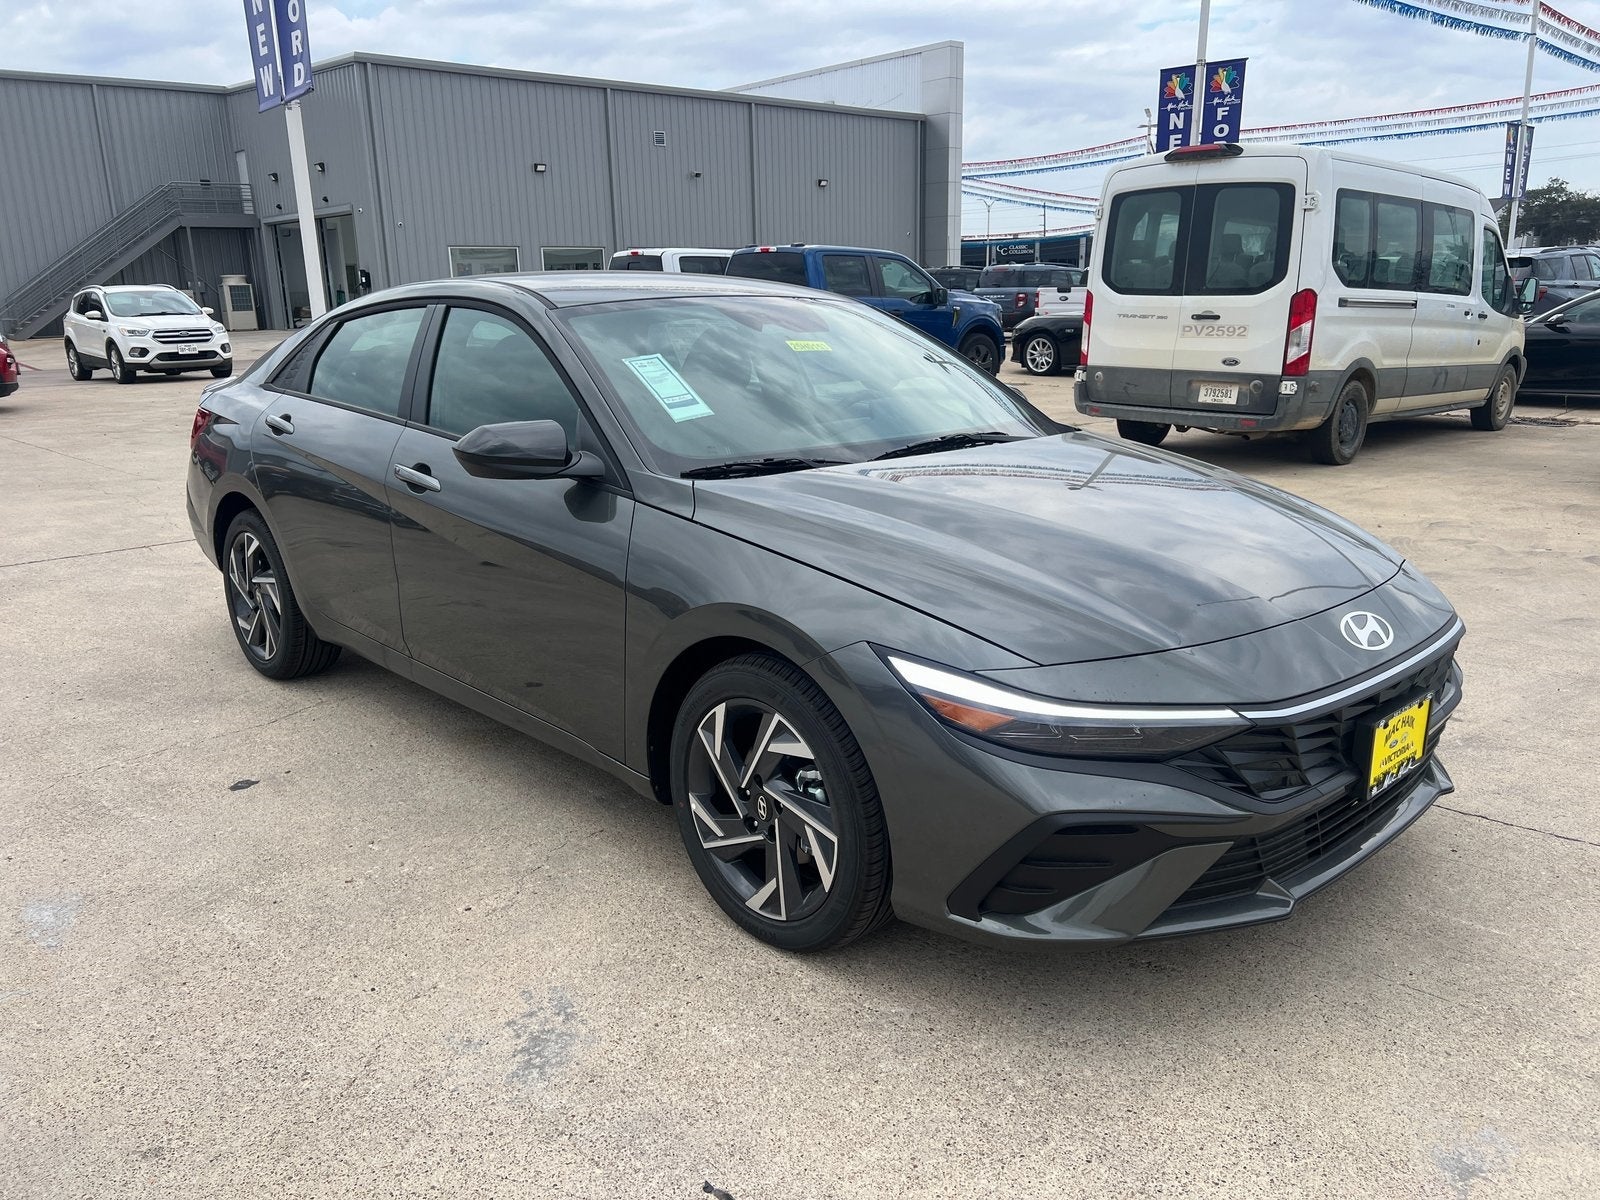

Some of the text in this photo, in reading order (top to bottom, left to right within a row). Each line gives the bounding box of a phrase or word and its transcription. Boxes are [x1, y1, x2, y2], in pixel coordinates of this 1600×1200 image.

[1213, 106, 1230, 144] FO
[1503, 153, 1512, 195] NEW
[1182, 325, 1248, 337] PV2592
[1203, 387, 1232, 399] 3792581
[1384, 718, 1401, 747] MAC
